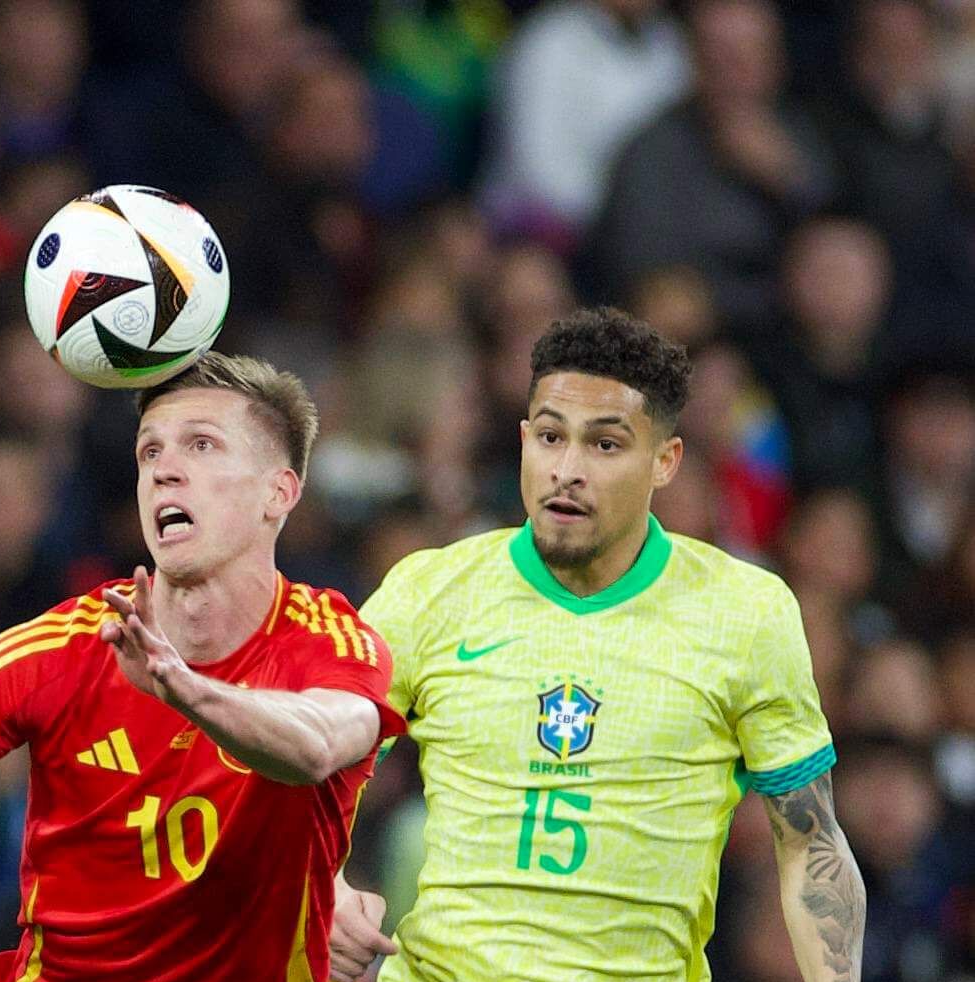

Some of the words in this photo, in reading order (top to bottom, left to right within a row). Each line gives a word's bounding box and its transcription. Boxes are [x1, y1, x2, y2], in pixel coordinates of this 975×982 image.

[555, 713, 578, 725] CBF
[529, 760, 593, 777] BRASIL
[126, 795, 219, 882] 10
[517, 787, 592, 875] 15
